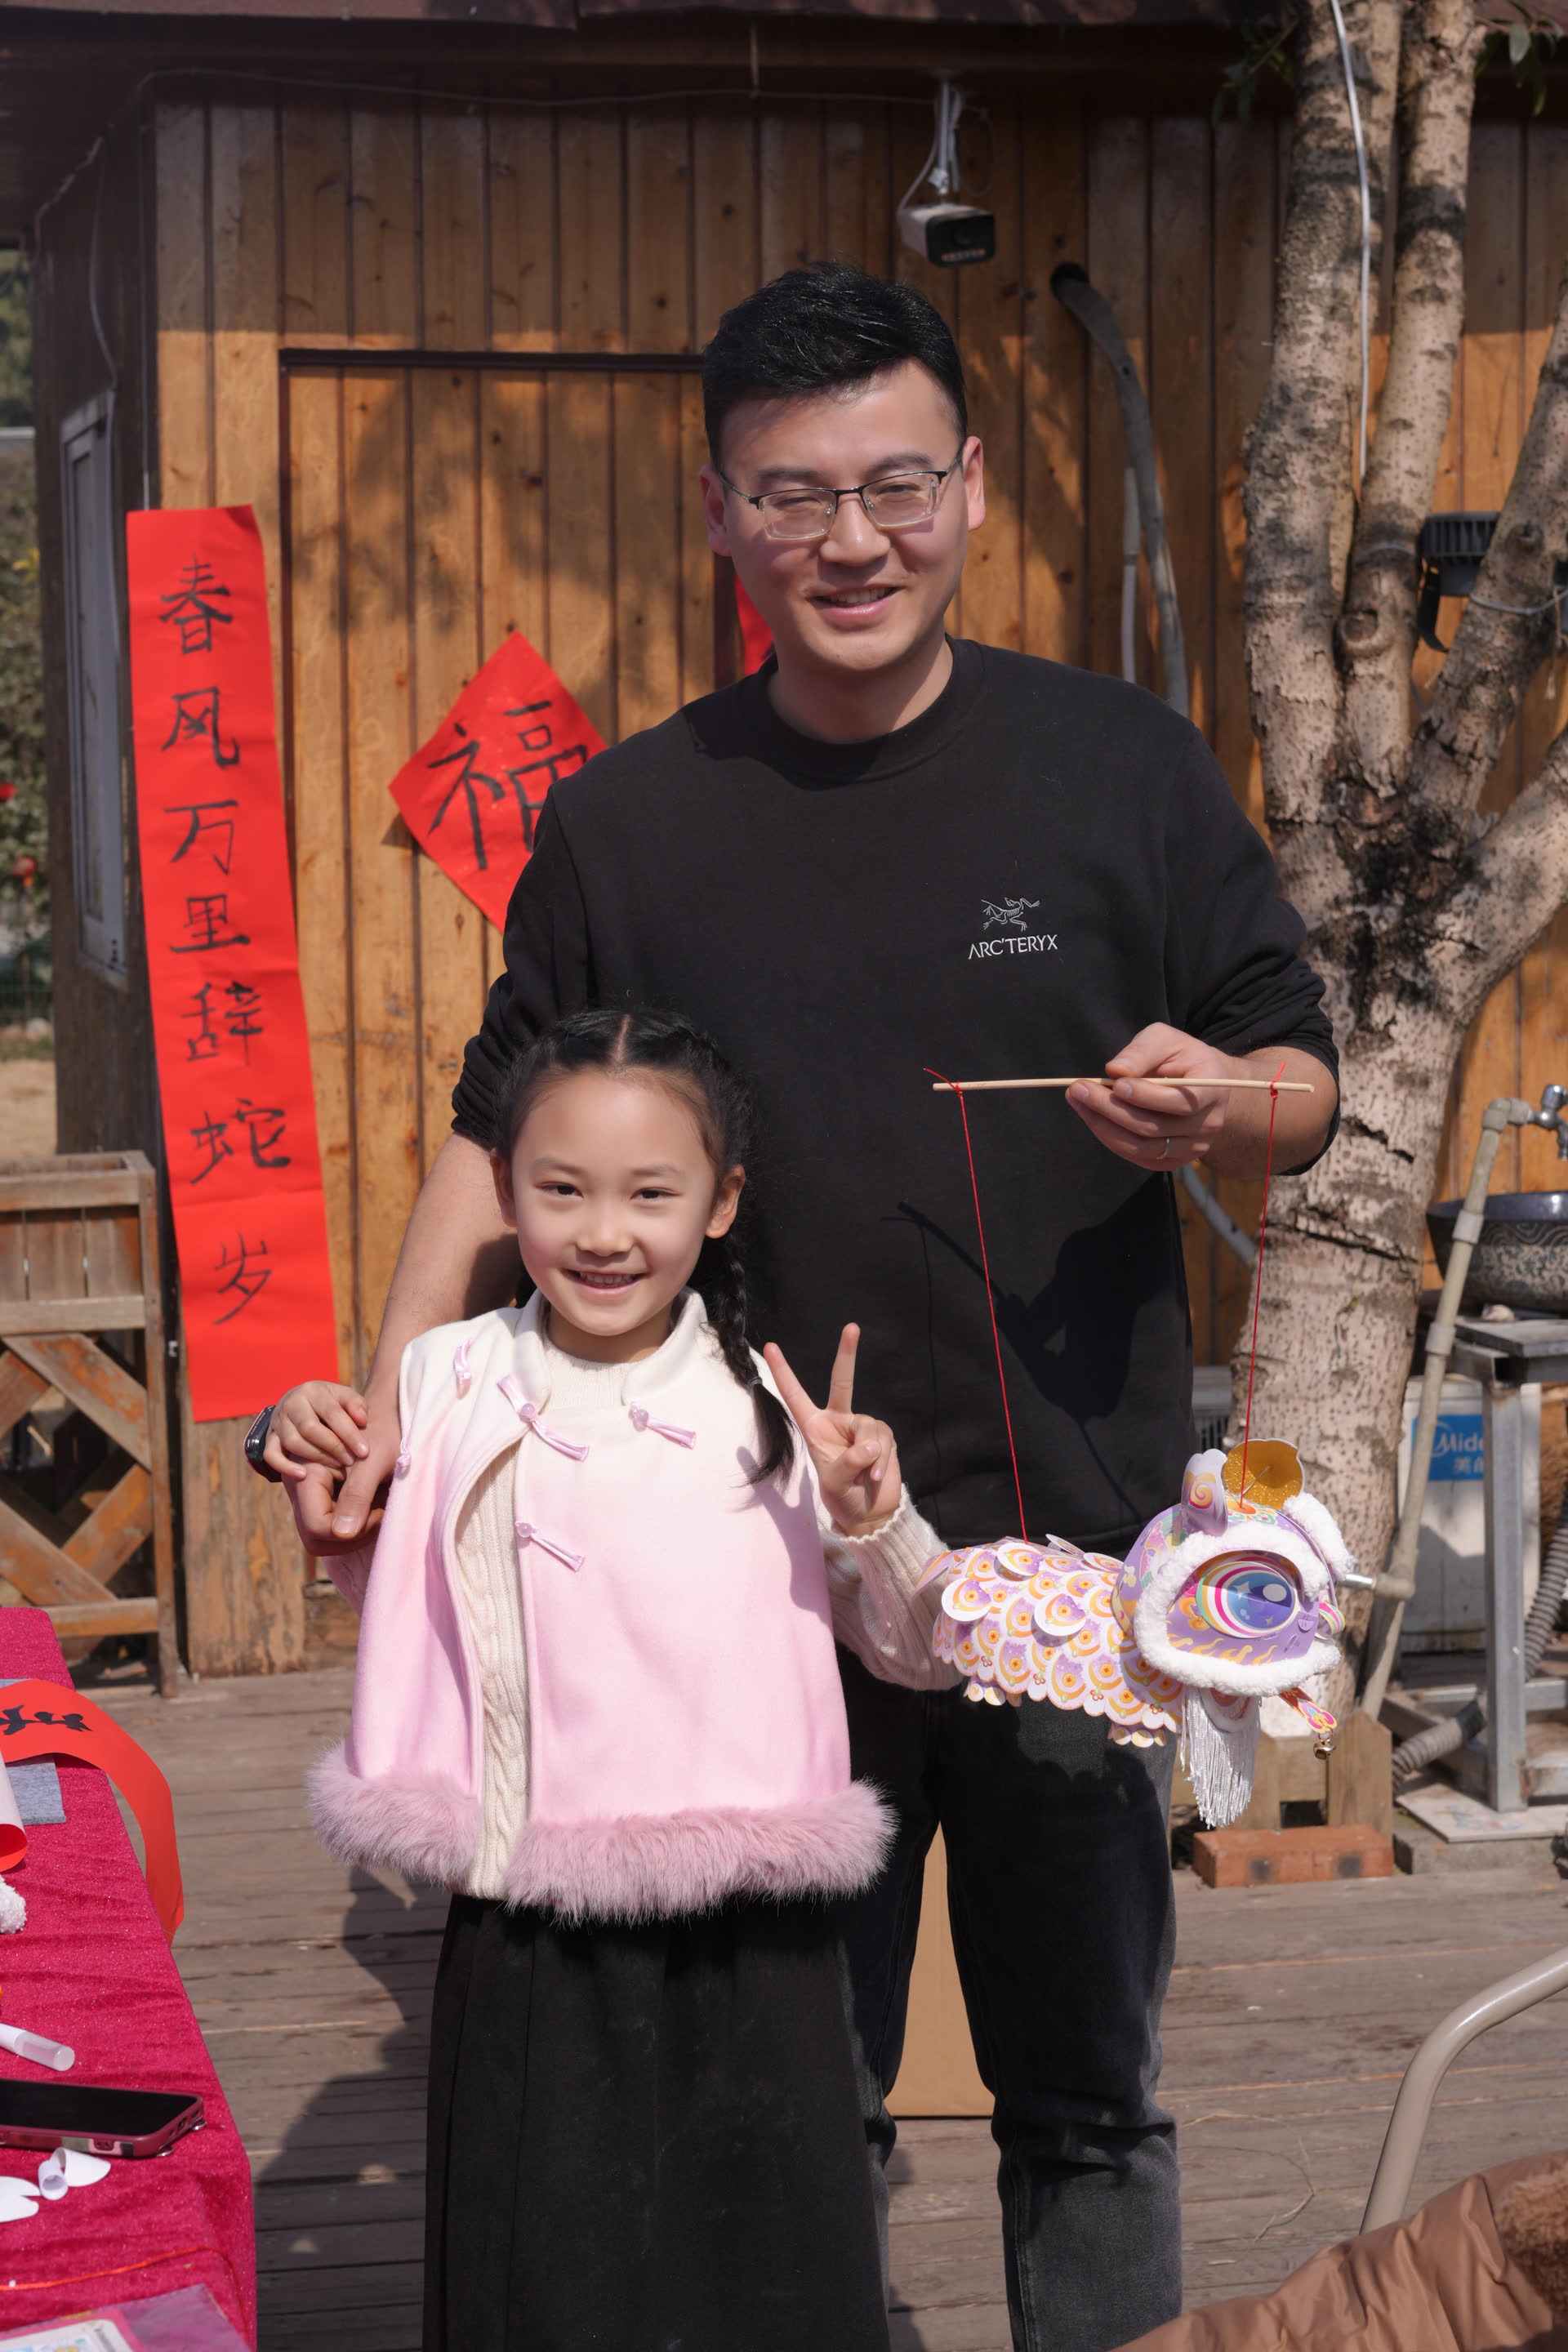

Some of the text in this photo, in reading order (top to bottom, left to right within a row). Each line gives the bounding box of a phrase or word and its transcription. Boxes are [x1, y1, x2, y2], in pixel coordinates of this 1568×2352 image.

[426, 700, 588, 871] 福
[158, 552, 292, 1325] 春风万里辞蛇岁
[968, 934, 1058, 960] ARC'TERYX
